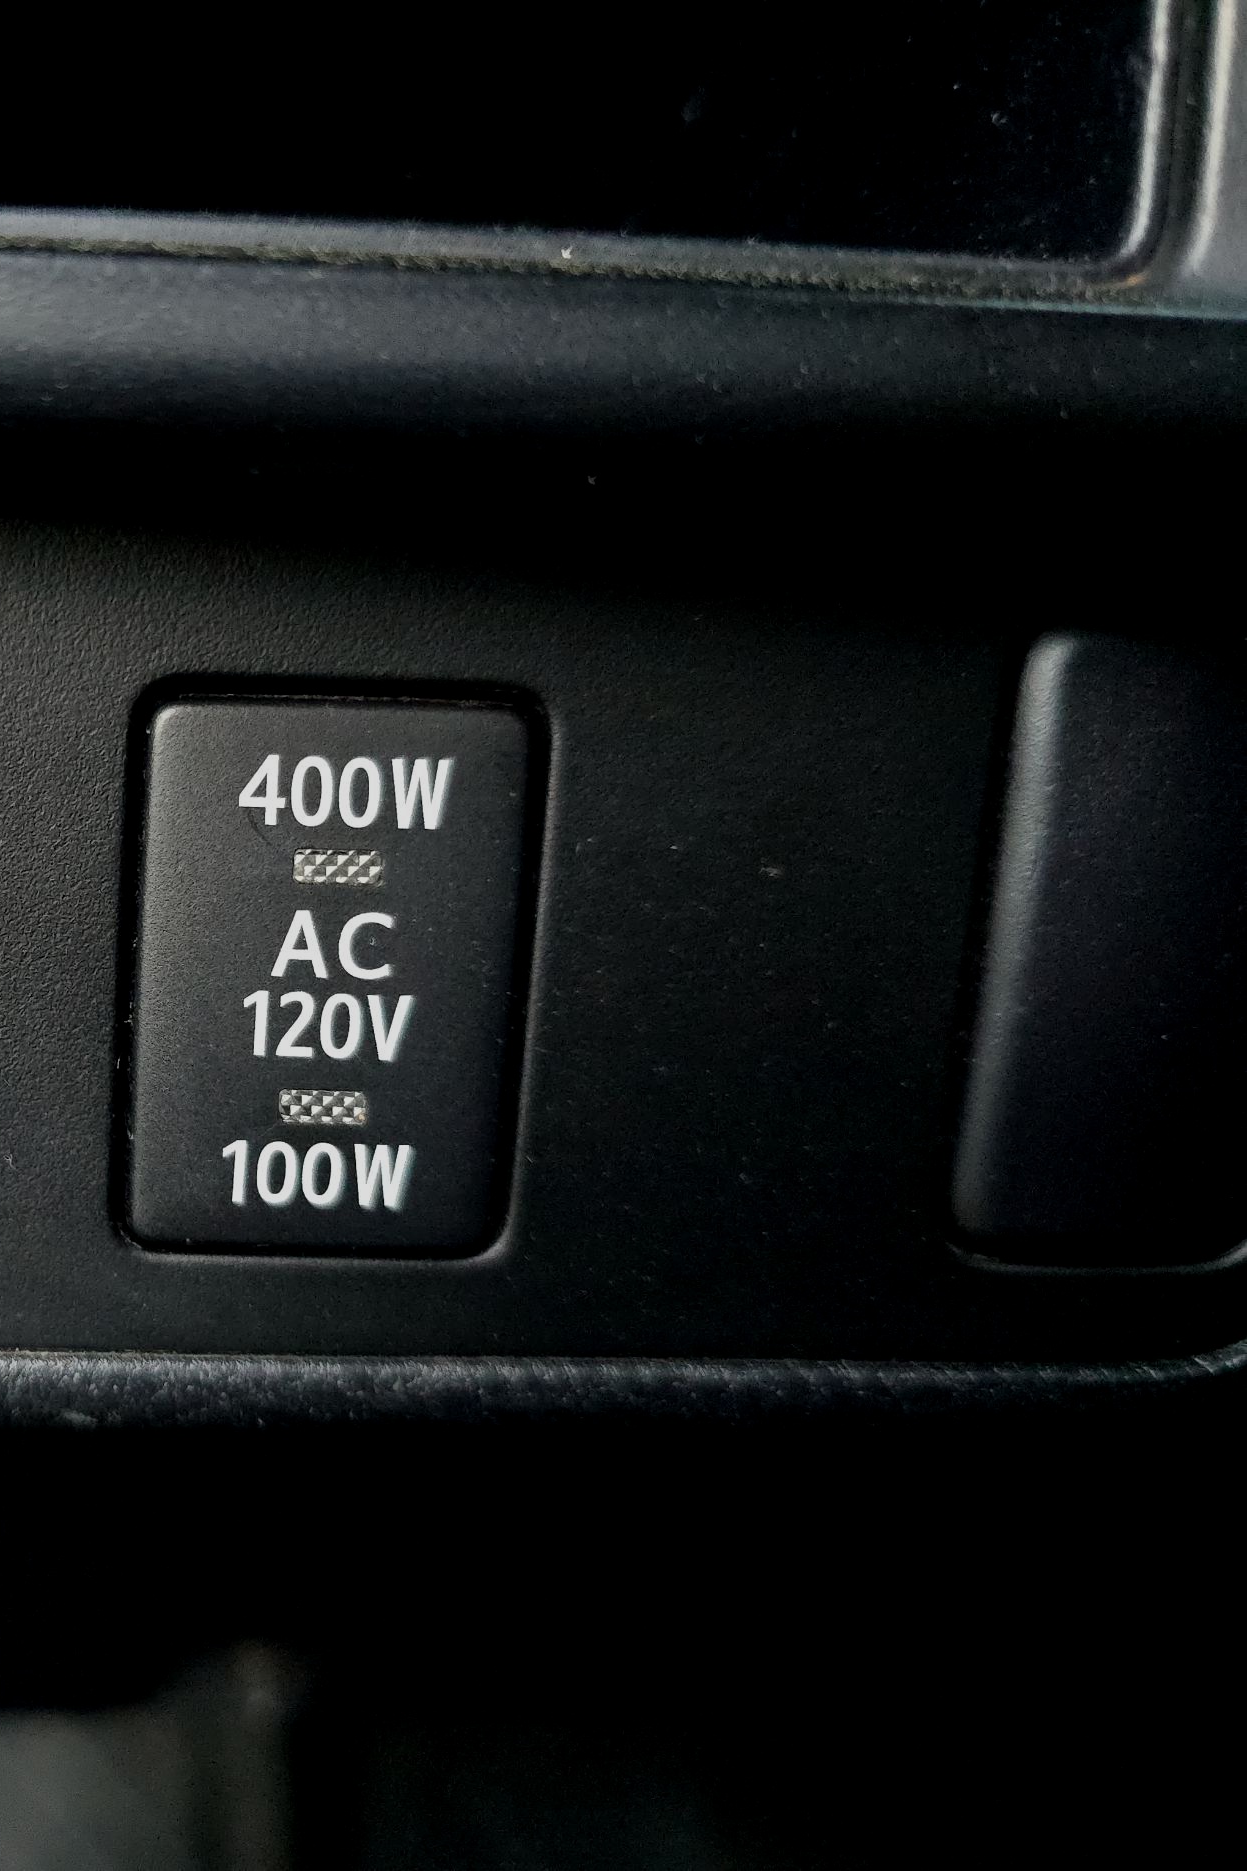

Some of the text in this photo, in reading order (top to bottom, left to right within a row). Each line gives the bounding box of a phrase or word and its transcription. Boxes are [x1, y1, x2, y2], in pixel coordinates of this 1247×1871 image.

[238, 754, 455, 831] 400W
[271, 910, 395, 981] AC
[244, 990, 415, 1063] 120V
[223, 1140, 413, 1211] 100W
